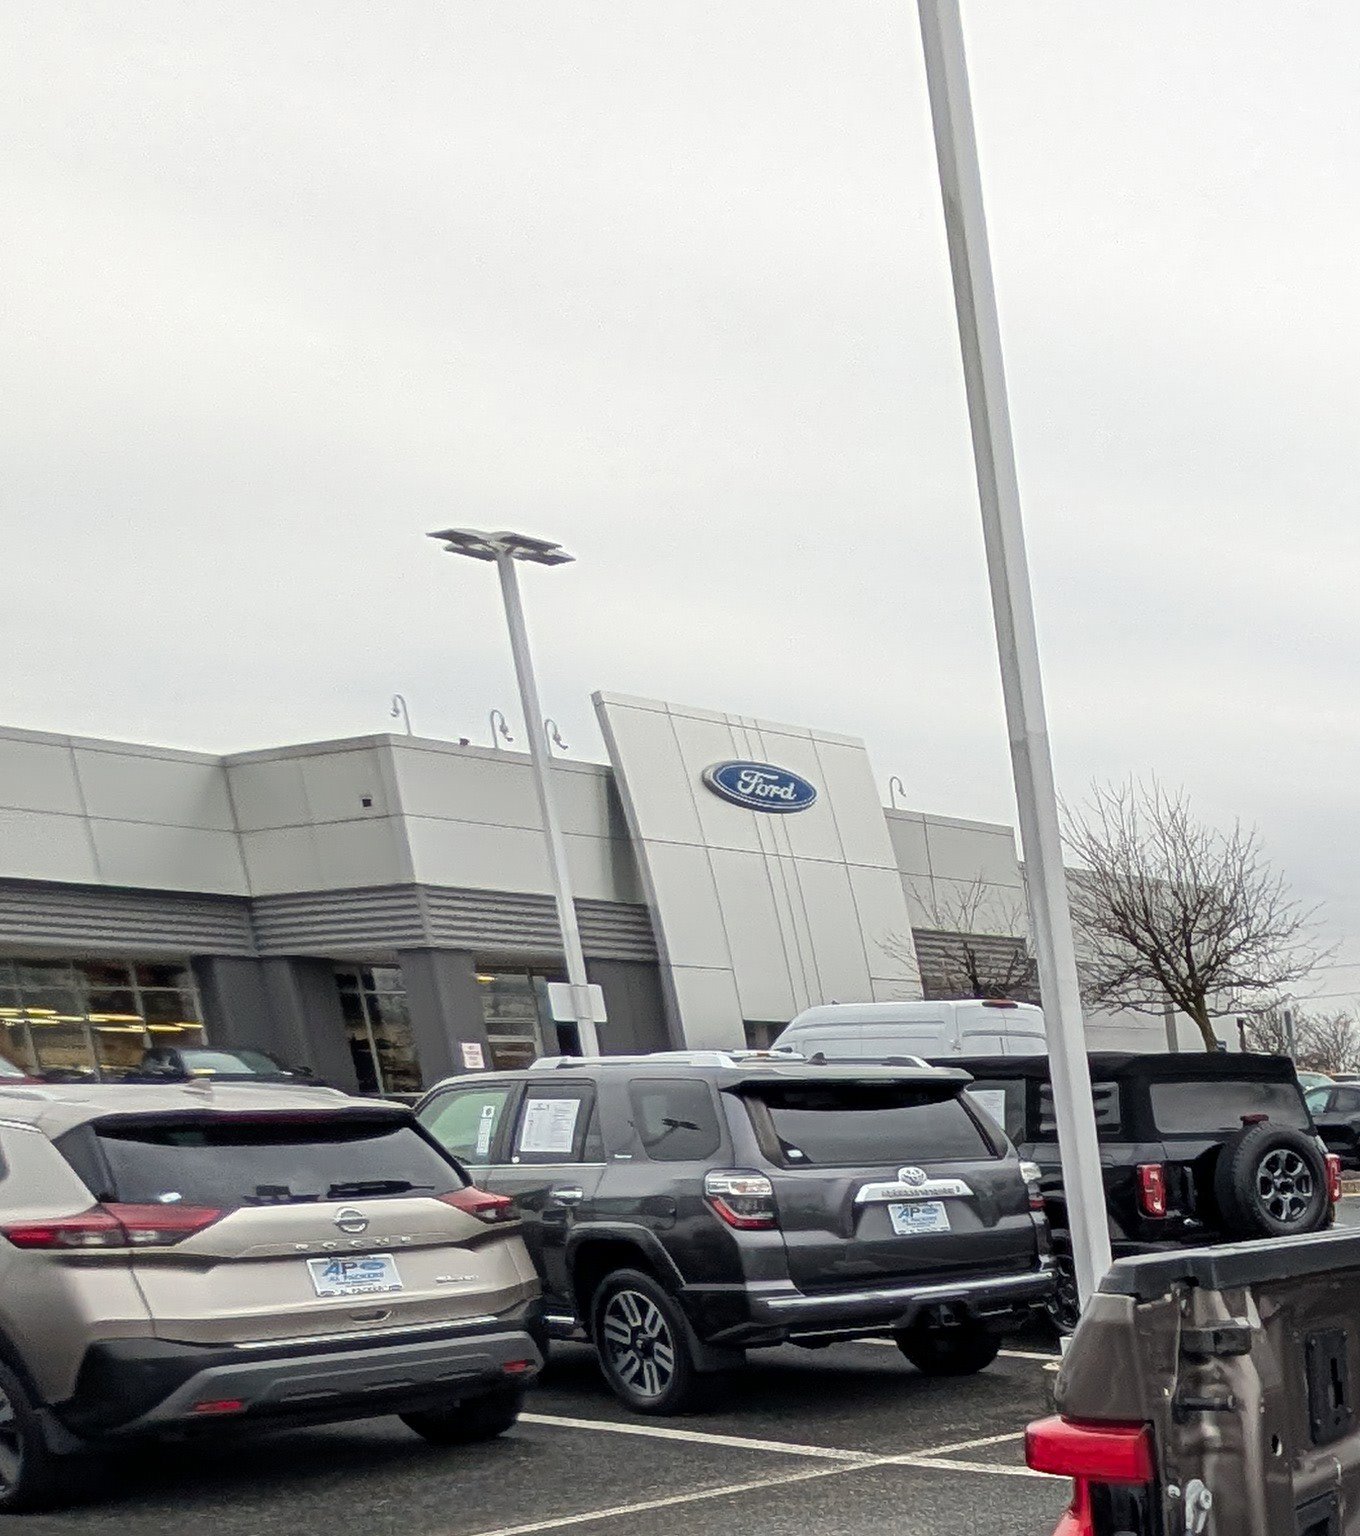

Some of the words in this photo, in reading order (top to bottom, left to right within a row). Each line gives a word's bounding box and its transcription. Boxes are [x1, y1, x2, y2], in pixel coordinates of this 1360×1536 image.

[737, 770, 796, 799] Ford
[898, 1207, 920, 1219] AP
[322, 1259, 357, 1277] AP
